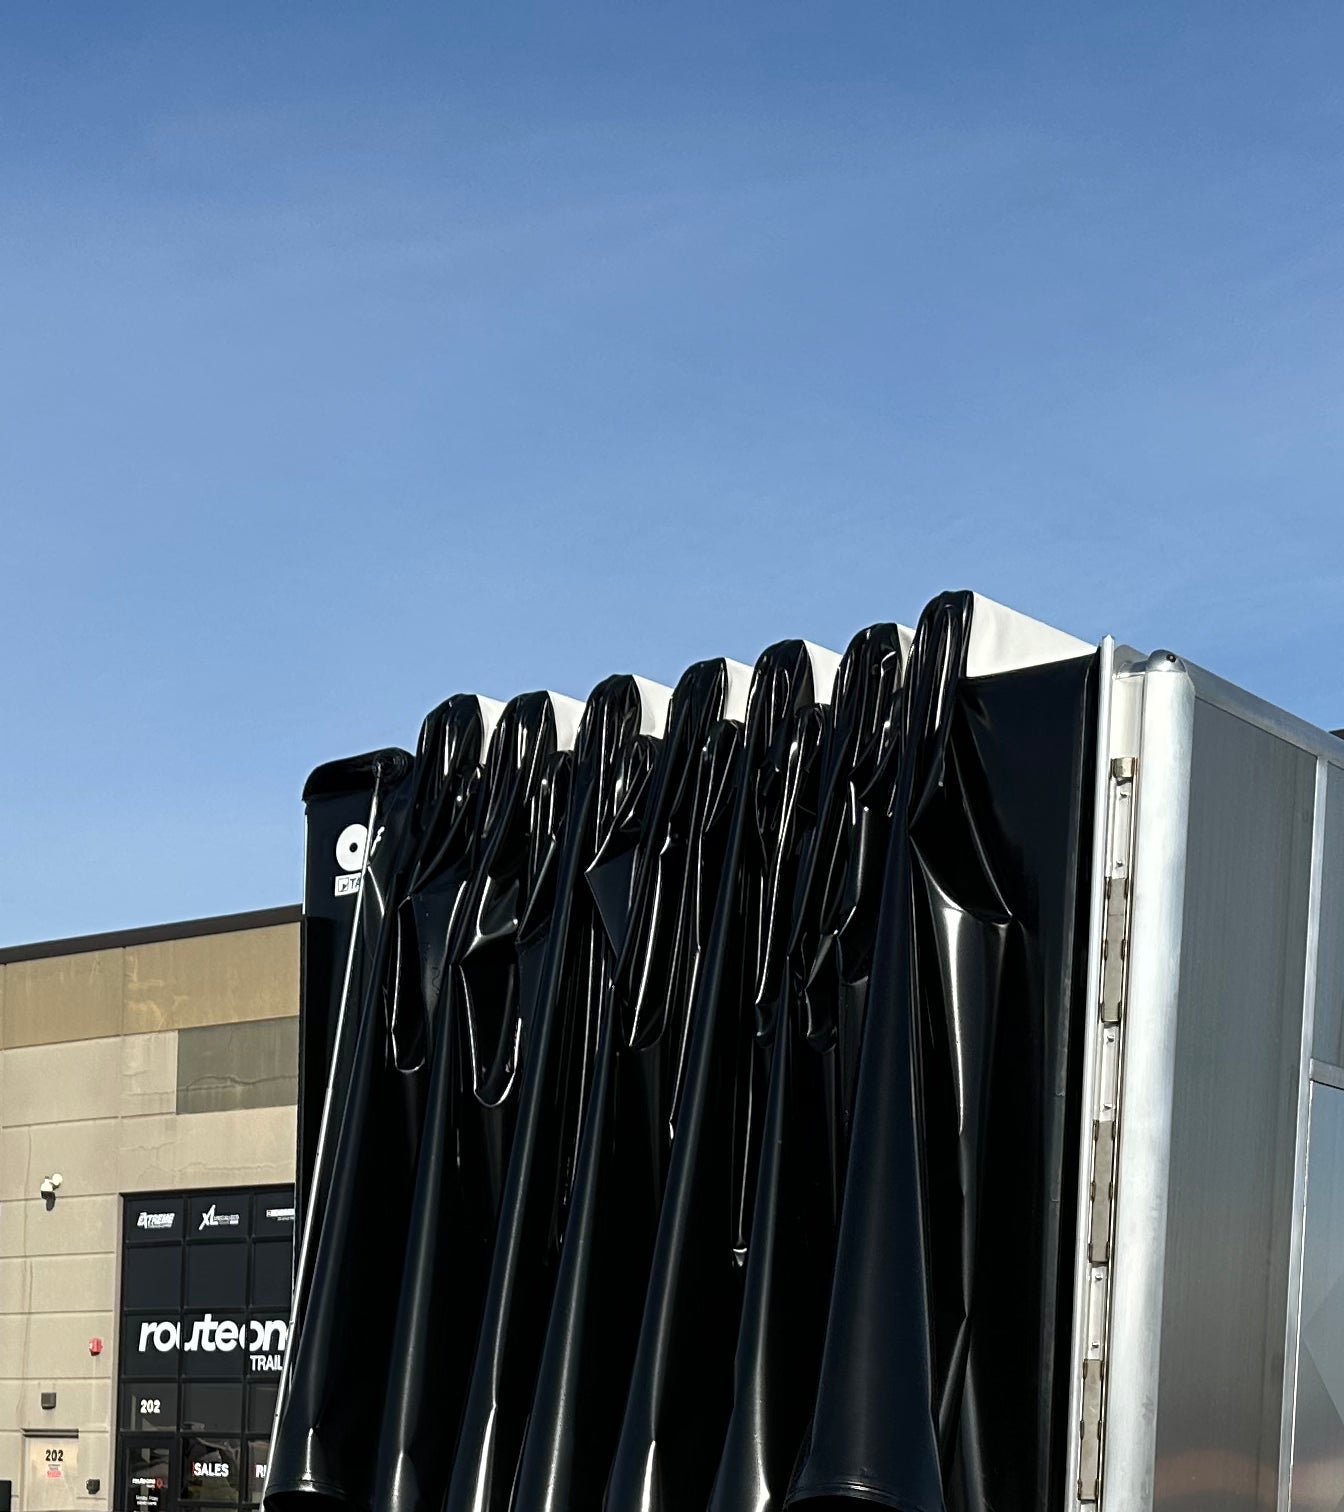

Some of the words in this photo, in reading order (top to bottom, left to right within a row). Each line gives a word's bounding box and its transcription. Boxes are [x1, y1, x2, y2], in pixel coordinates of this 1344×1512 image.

[138, 1313, 289, 1352] routeon
[249, 1354, 282, 1371] TRAIL
[140, 1399, 161, 1414] 202
[45, 1449, 64, 1462] 202
[193, 1462, 229, 1478] SALES
